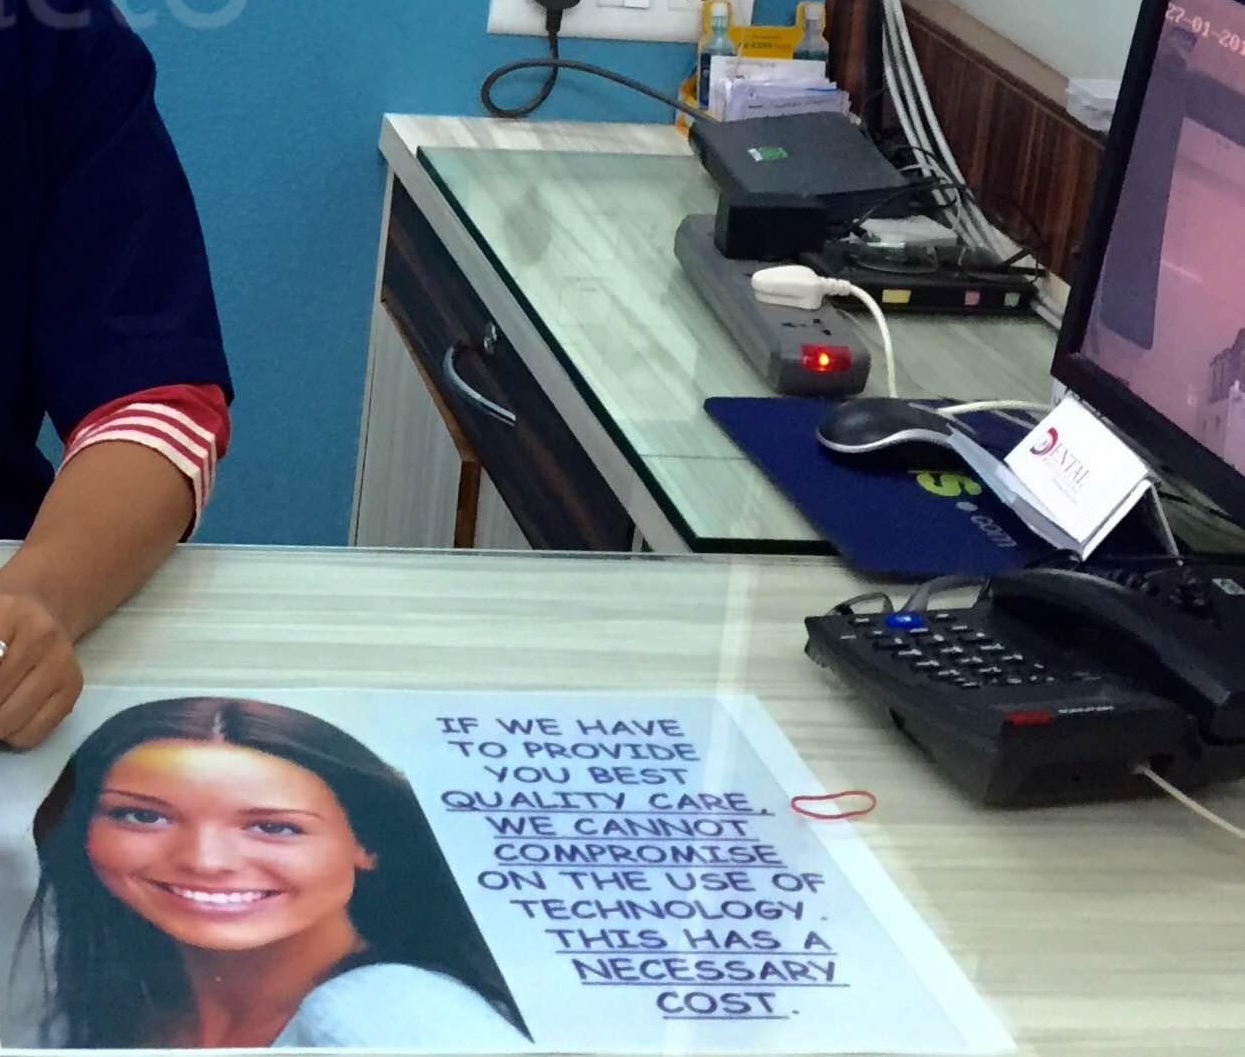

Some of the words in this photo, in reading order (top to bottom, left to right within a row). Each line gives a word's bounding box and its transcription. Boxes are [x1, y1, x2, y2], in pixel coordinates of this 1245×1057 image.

[436, 717, 479, 735] IF
[497, 718, 563, 736] WE
[579, 719, 685, 737] HAVE
[447, 741, 509, 759] TO
[525, 742, 700, 761] PROVIDE
[484, 766, 570, 785] YOU
[588, 767, 689, 785] BEST
[441, 790, 625, 811] QUALITY
[486, 816, 559, 836] WE
[573, 818, 748, 837] CANNOT
[494, 843, 783, 865] COMPROMISE
[477, 870, 547, 891] ON
[559, 871, 653, 892] THE
[668, 871, 756, 892] USE
[771, 872, 826, 893] OF
[545, 928, 667, 950] THIS
[683, 929, 782, 951] HAS
[803, 931, 833, 951] A
[572, 958, 837, 983] NECESSARY
[655, 991, 800, 1017] COST.
